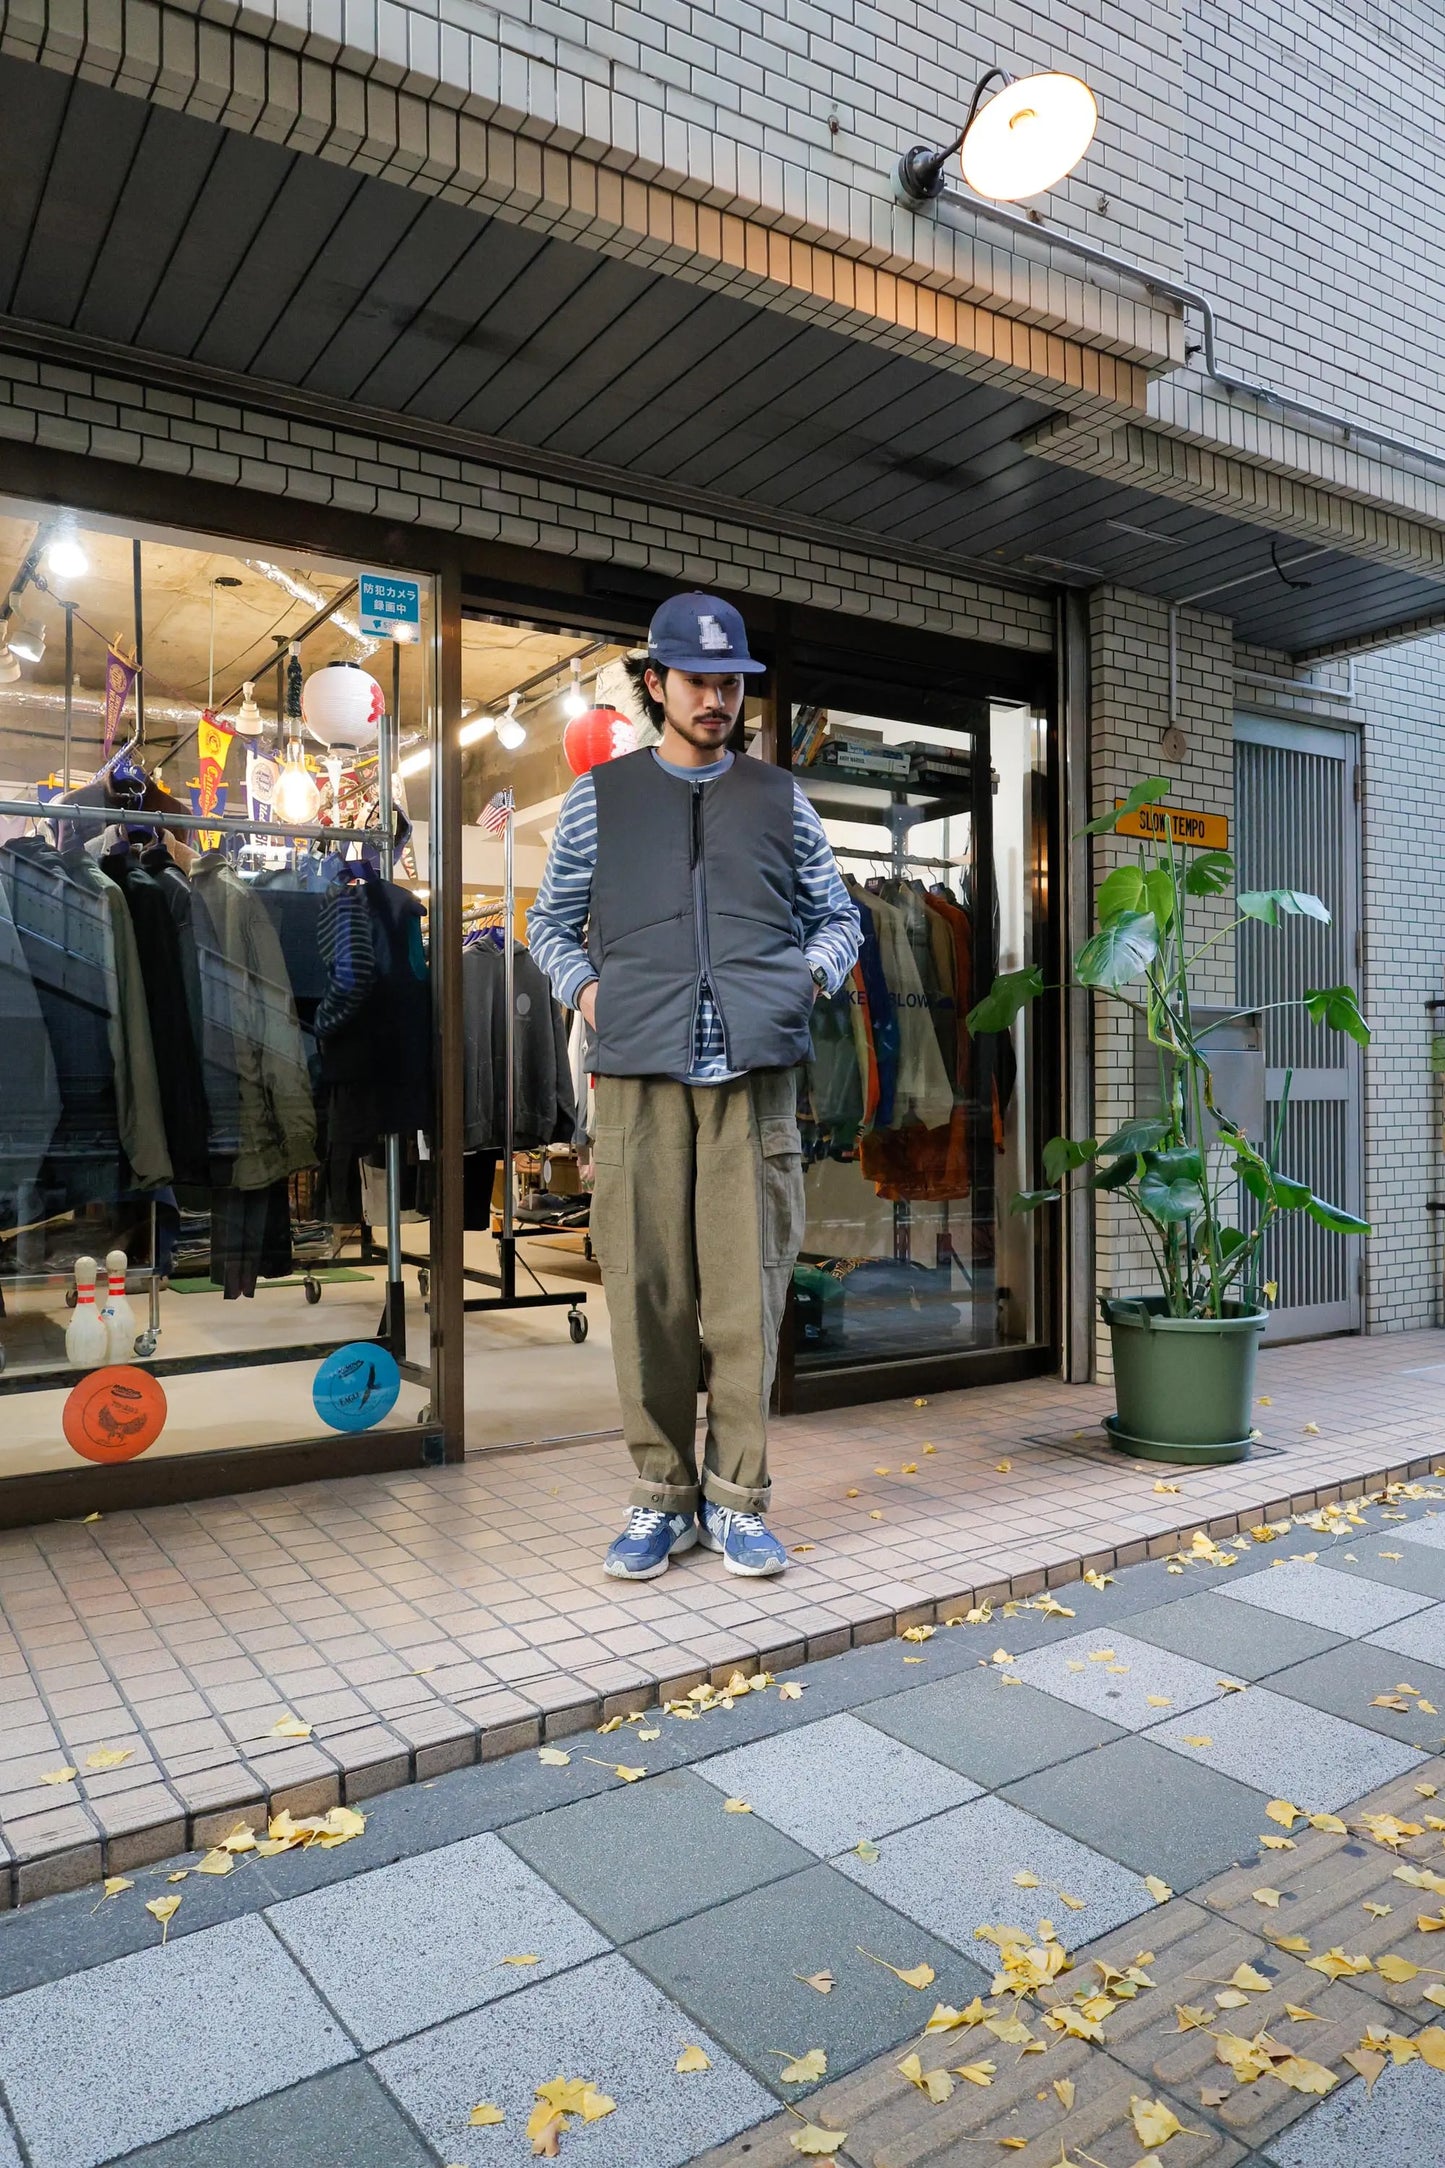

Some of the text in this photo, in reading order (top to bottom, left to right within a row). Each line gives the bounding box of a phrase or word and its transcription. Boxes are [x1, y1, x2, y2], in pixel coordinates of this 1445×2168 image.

[363, 582, 416, 601] 防犯カメラ
[374, 599, 407, 615] 録画中
[1139, 810, 1206, 839] SLOW TEMPO
